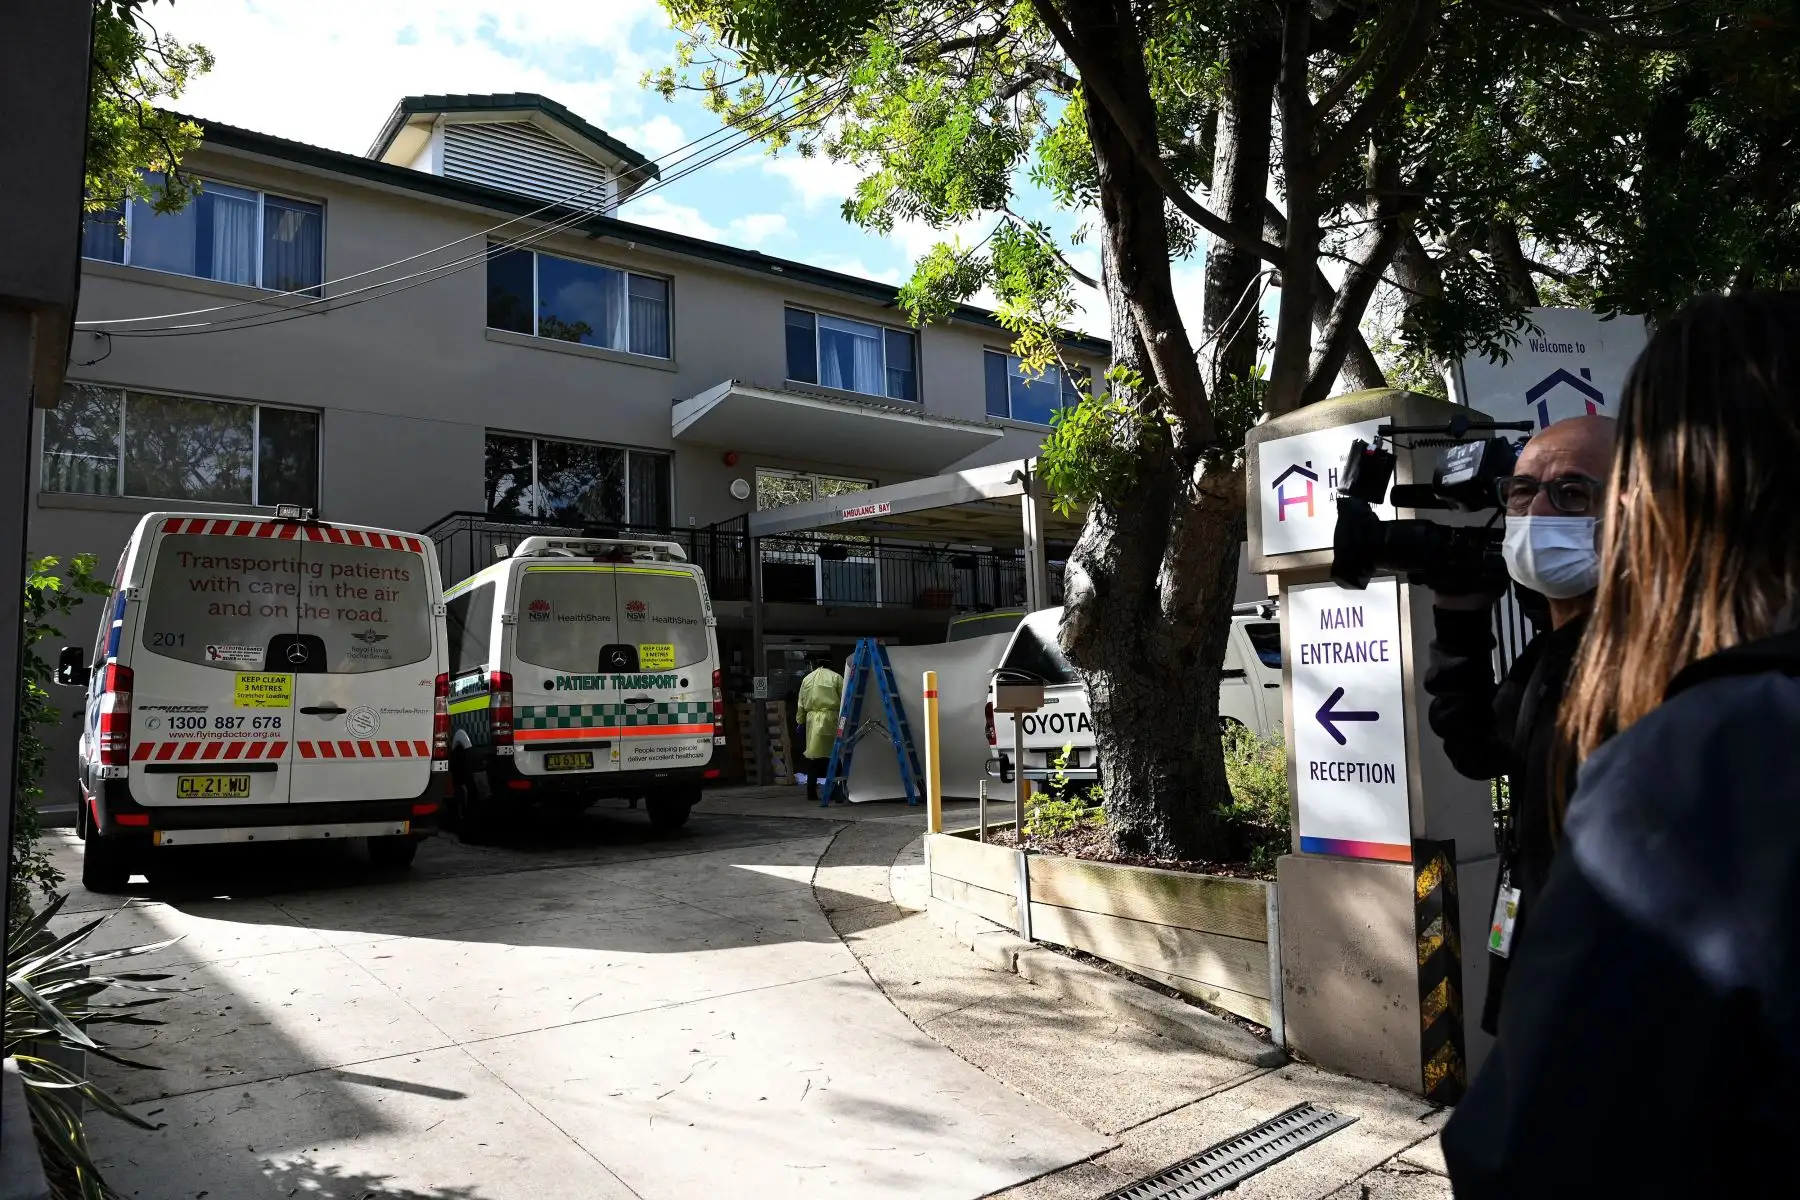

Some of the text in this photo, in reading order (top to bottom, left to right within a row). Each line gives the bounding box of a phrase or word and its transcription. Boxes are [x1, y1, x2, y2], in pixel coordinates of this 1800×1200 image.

[1529, 337, 1586, 354] Welcome to
[843, 503, 890, 518] AMBULANCE BAY
[176, 551, 410, 582] Transporting patients
[189, 574, 241, 594] with
[308, 581, 329, 598] in
[335, 582, 368, 600] the
[374, 586, 400, 602] air
[208, 600, 388, 623] and on the road.
[529, 612, 611, 623] NSW HealthShare
[626, 612, 698, 626] NSW HealthShare
[1320, 606, 1364, 630] MAIN
[153, 632, 185, 648] 201
[1300, 640, 1389, 665] ENTRANCE
[251, 684, 283, 692] METRES
[262, 676, 286, 684] CLEAR
[556, 674, 679, 691] PATIENT TRANSPORT
[167, 716, 282, 730] 1300 887 678
[1010, 712, 1093, 735] OYOTA
[168, 730, 281, 740] www.flyingdoctor.org.au
[1309, 761, 1396, 784] RECEPTION
